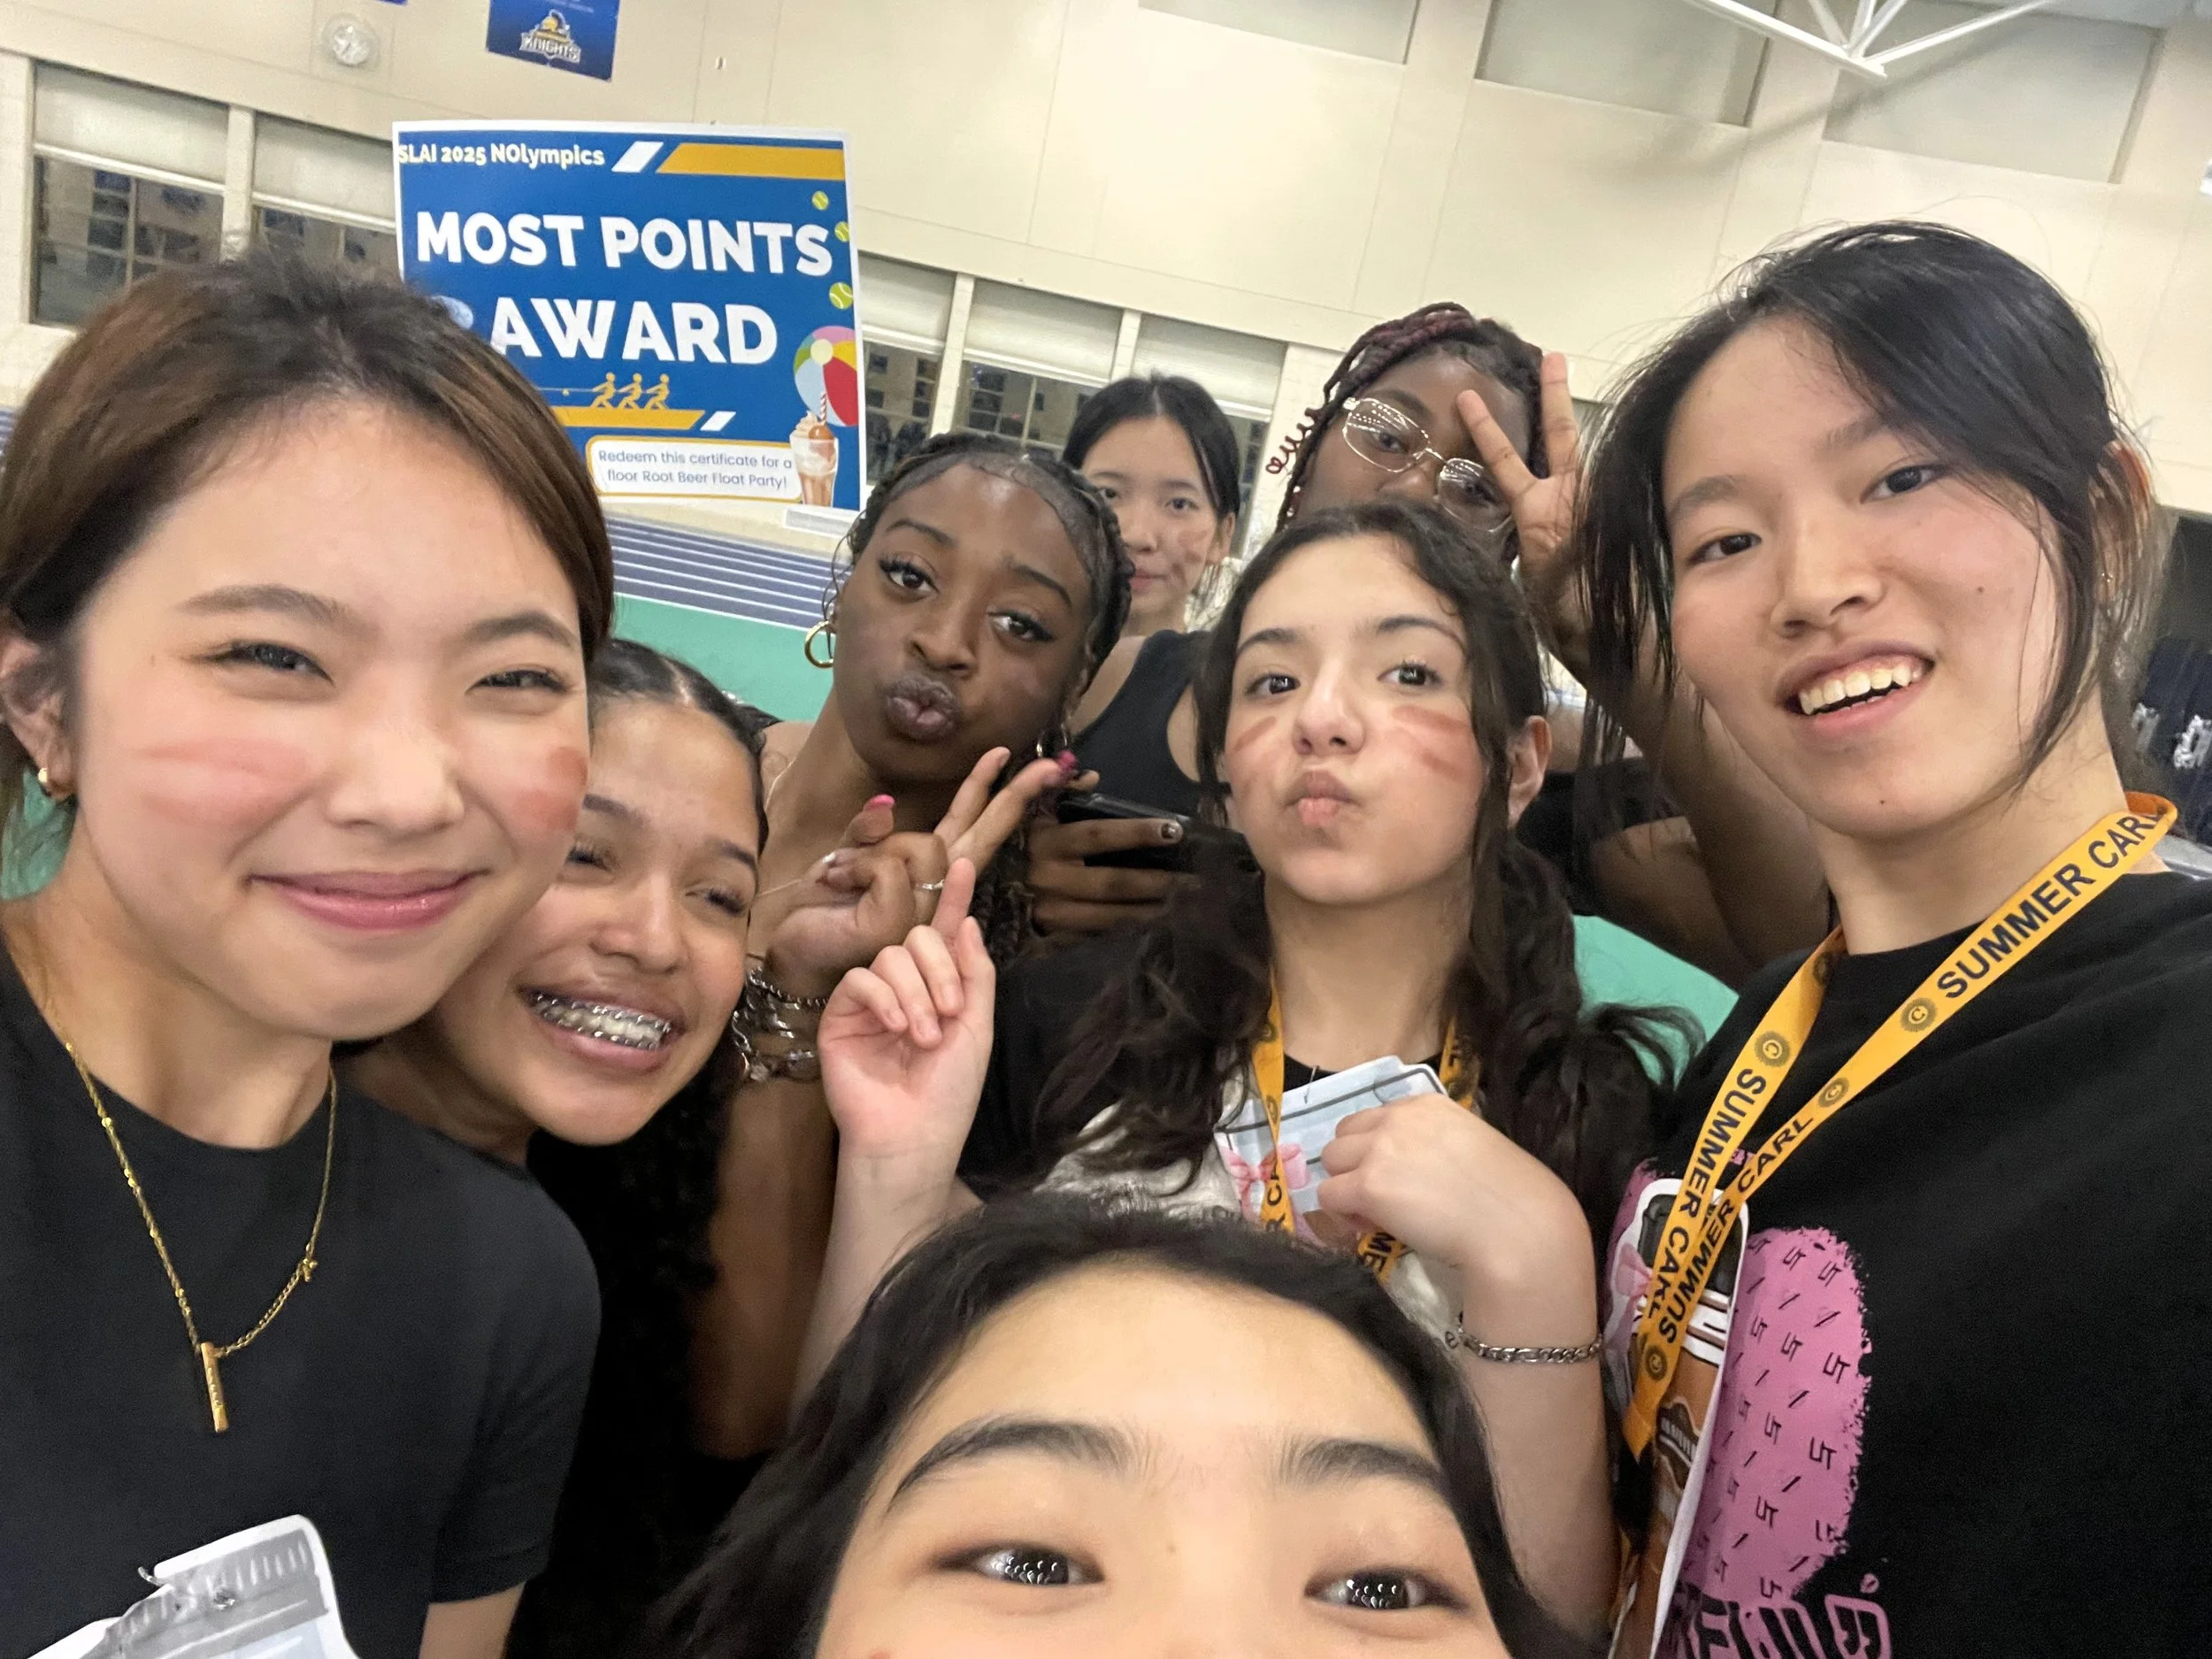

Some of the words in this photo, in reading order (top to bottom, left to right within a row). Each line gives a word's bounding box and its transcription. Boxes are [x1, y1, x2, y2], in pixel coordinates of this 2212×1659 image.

[398, 144, 436, 163] SLAI
[441, 146, 486, 165] 2025
[490, 142, 605, 170] NOlympics
[417, 211, 584, 267] MOST
[600, 216, 833, 277] POINTS
[490, 296, 778, 365] AWARD
[598, 449, 657, 463] Redeem
[661, 451, 686, 464] this
[689, 453, 757, 467] certificate
[762, 456, 780, 468] for
[784, 459, 792, 469] a
[608, 469, 638, 481] floor
[643, 470, 673, 482] Root
[679, 472, 708, 484] Beer
[712, 473, 744, 486] Float
[749, 475, 787, 490] Party!
[1937, 863, 2096, 998] SUMMER
[1678, 1068, 1767, 1220] SUMMER
[1659, 1198, 1734, 1343] SUMMER
[1738, 1116, 1814, 1193] CARL
